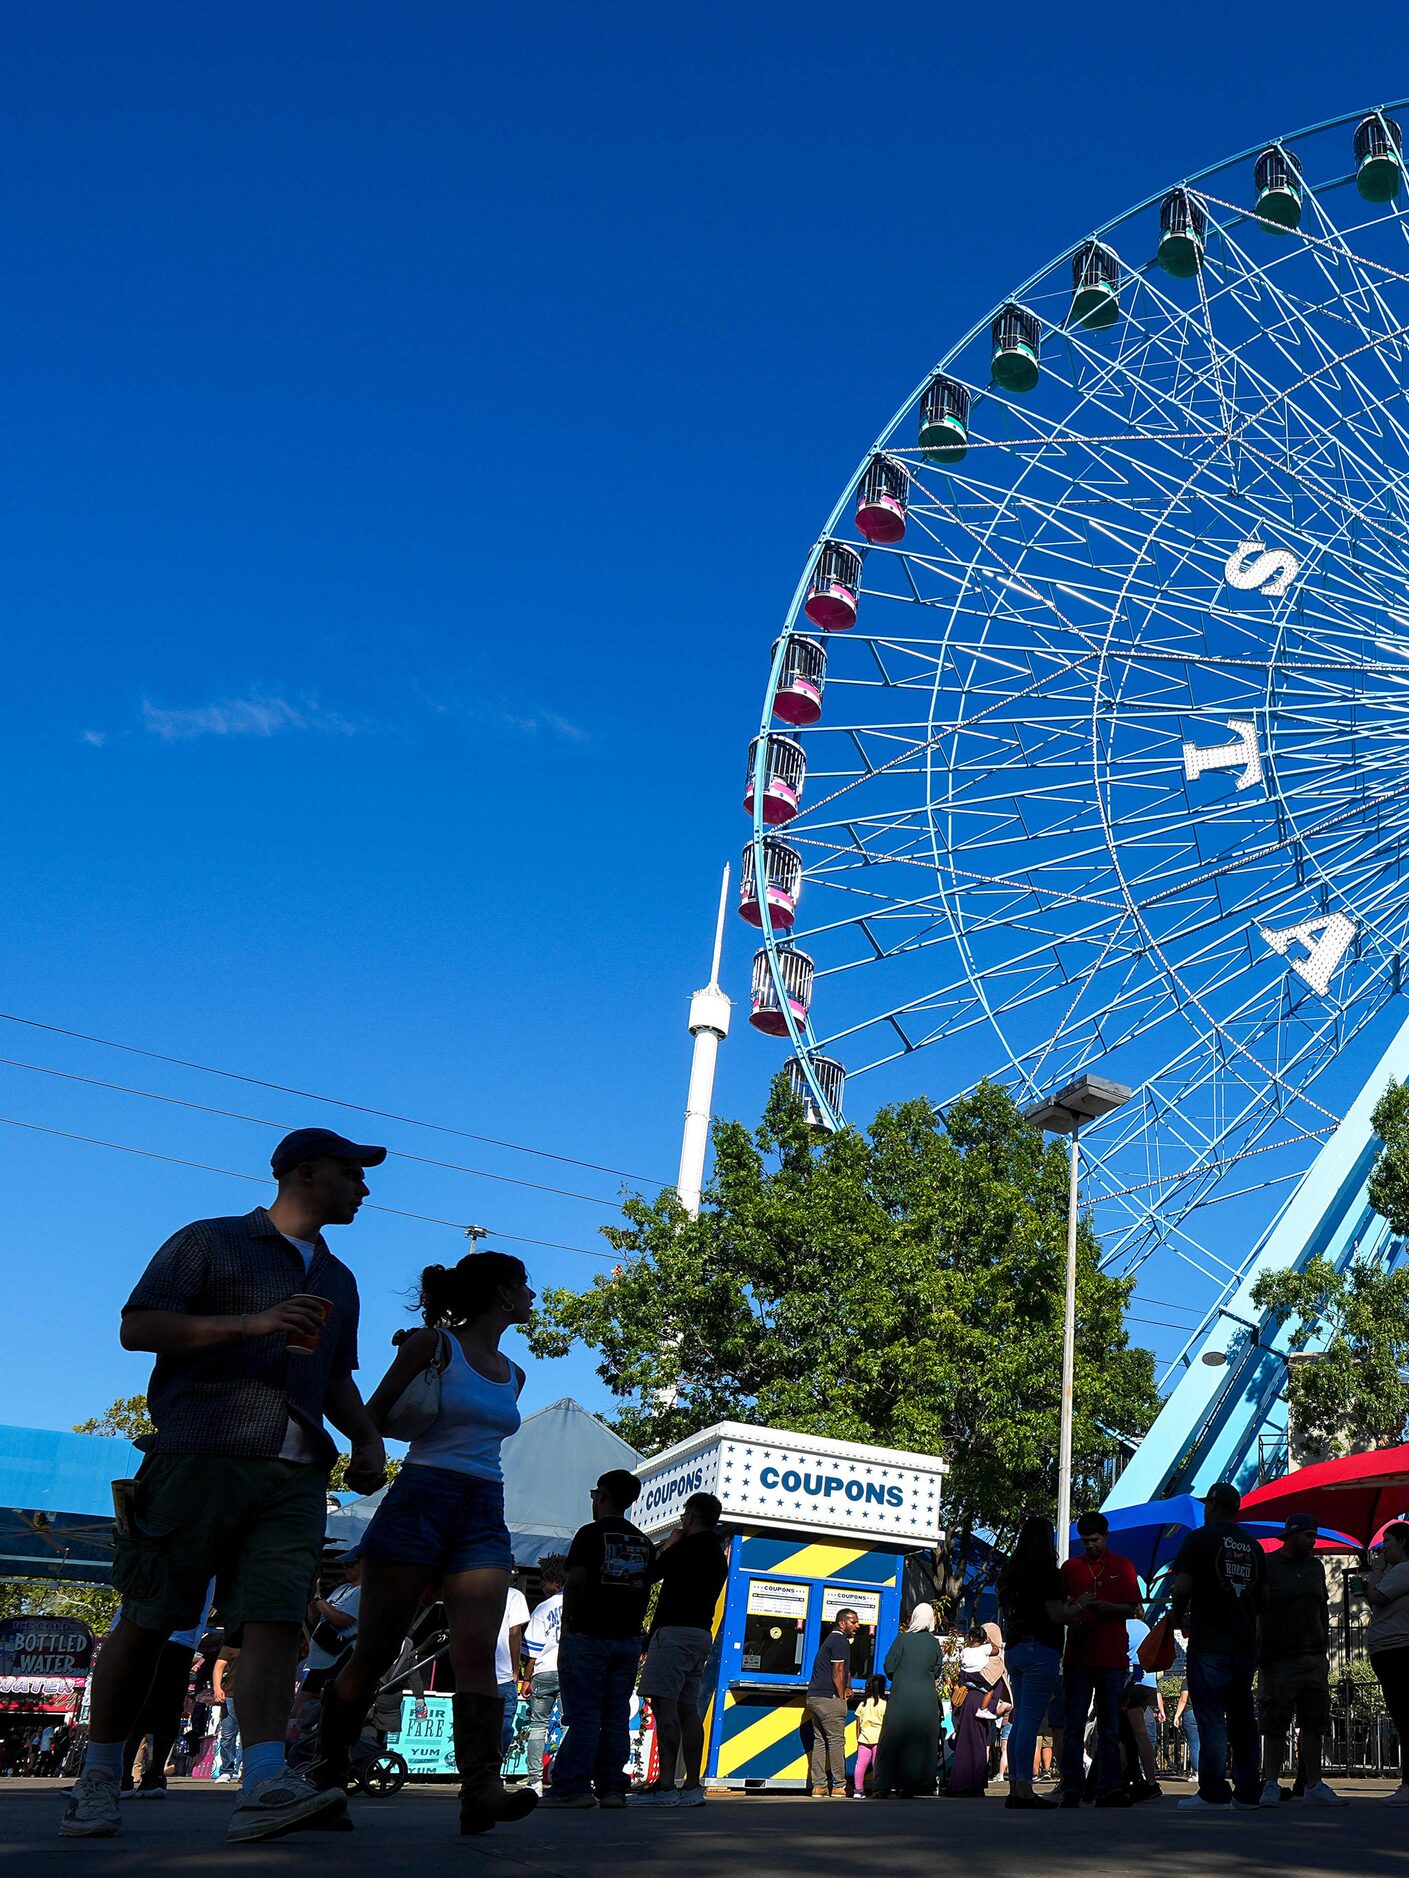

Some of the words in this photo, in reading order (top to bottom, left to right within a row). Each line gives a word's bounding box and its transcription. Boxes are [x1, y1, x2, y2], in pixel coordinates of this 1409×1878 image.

[645, 1467, 703, 1511] COUPONS
[759, 1466, 904, 1508] COUPONS
[1222, 1536, 1252, 1553] Coors
[1226, 1563, 1250, 1577] RODEO
[764, 1585, 795, 1593] COUPONS
[837, 1592, 867, 1600] COUPONS
[14, 1633, 87, 1652] BOTTLED
[20, 1655, 76, 1674] WATER
[406, 1718, 445, 1738] FARE
